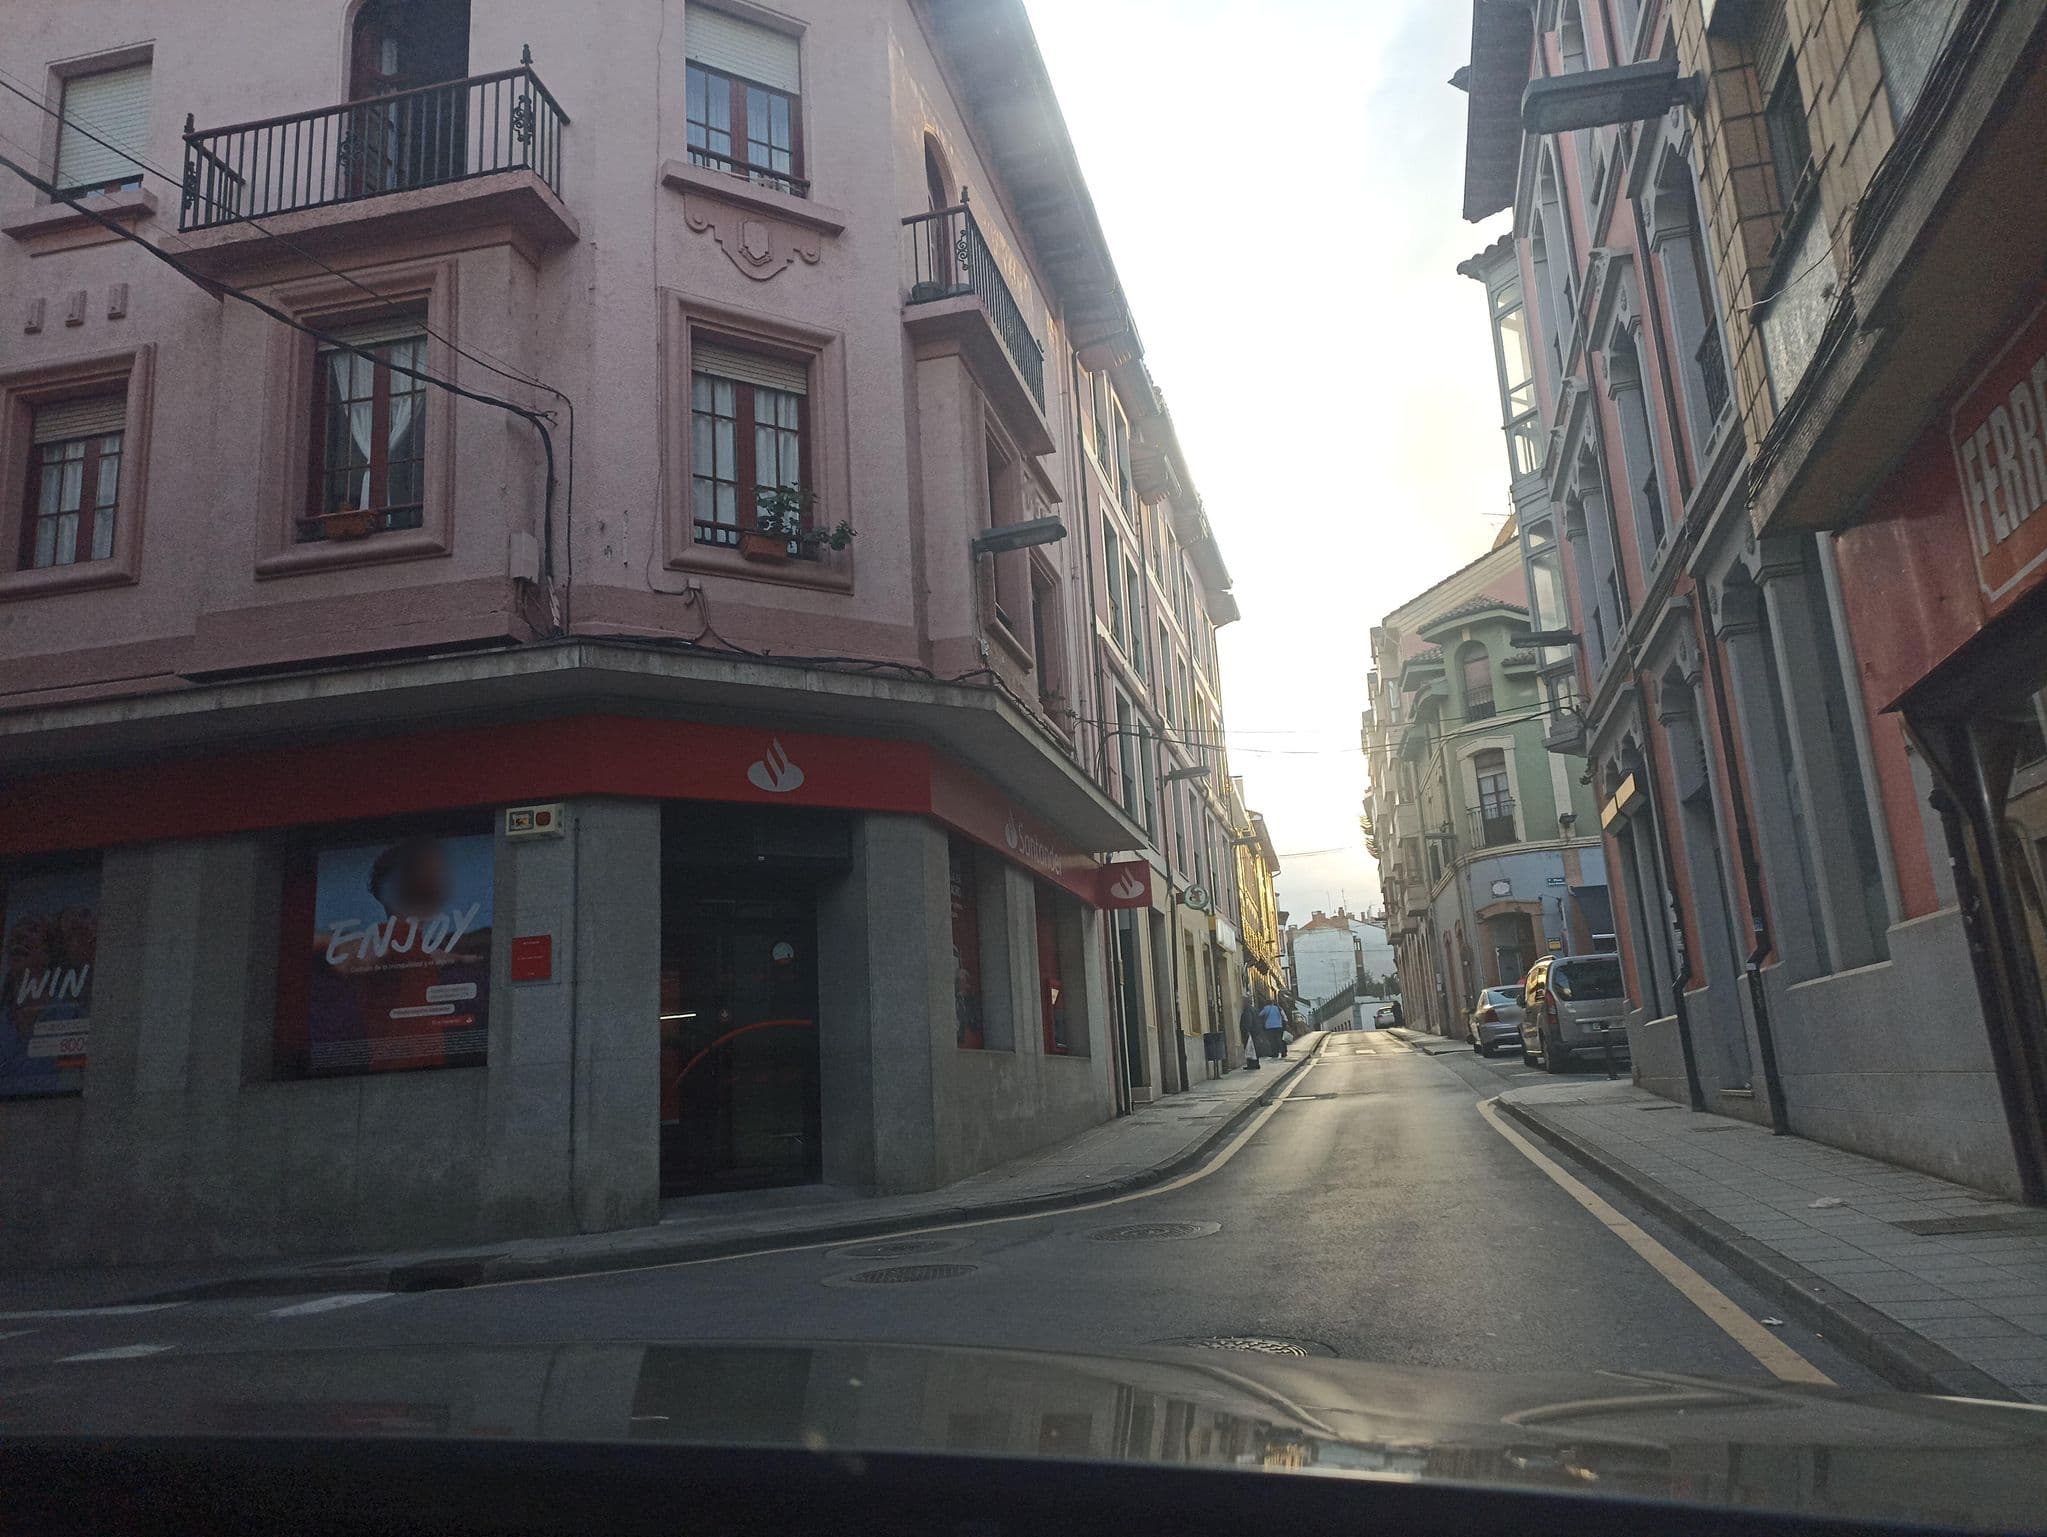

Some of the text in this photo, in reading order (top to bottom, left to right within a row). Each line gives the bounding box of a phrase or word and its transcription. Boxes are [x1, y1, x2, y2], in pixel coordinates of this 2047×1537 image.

[1018, 823, 1062, 876] Santander
[326, 903, 480, 965] ENJOY
[17, 964, 90, 1005] WIN
